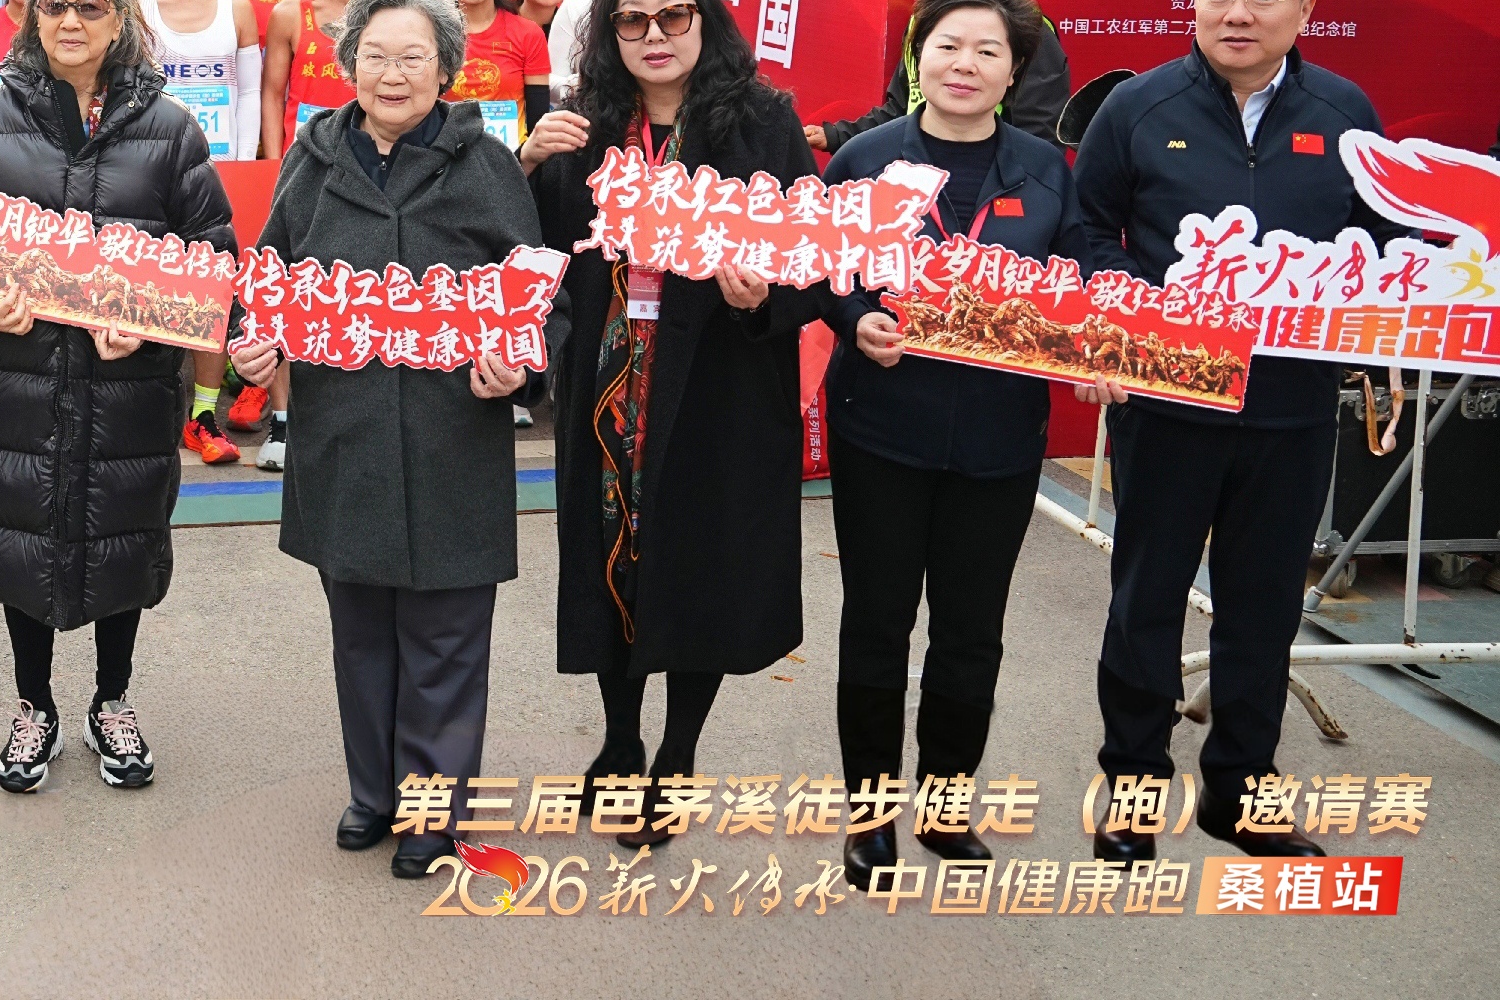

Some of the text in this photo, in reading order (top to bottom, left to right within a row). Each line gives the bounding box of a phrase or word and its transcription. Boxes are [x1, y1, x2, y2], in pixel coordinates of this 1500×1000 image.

[593, 150, 873, 234] 传承红色基因
[100, 230, 235, 281] 敬红色传承
[236, 250, 506, 317] 传承红色基因
[647, 221, 910, 293] 筑梦健康中国
[1090, 275, 1256, 332] 敬红色传承
[302, 313, 544, 367] 筑梦健康中国
